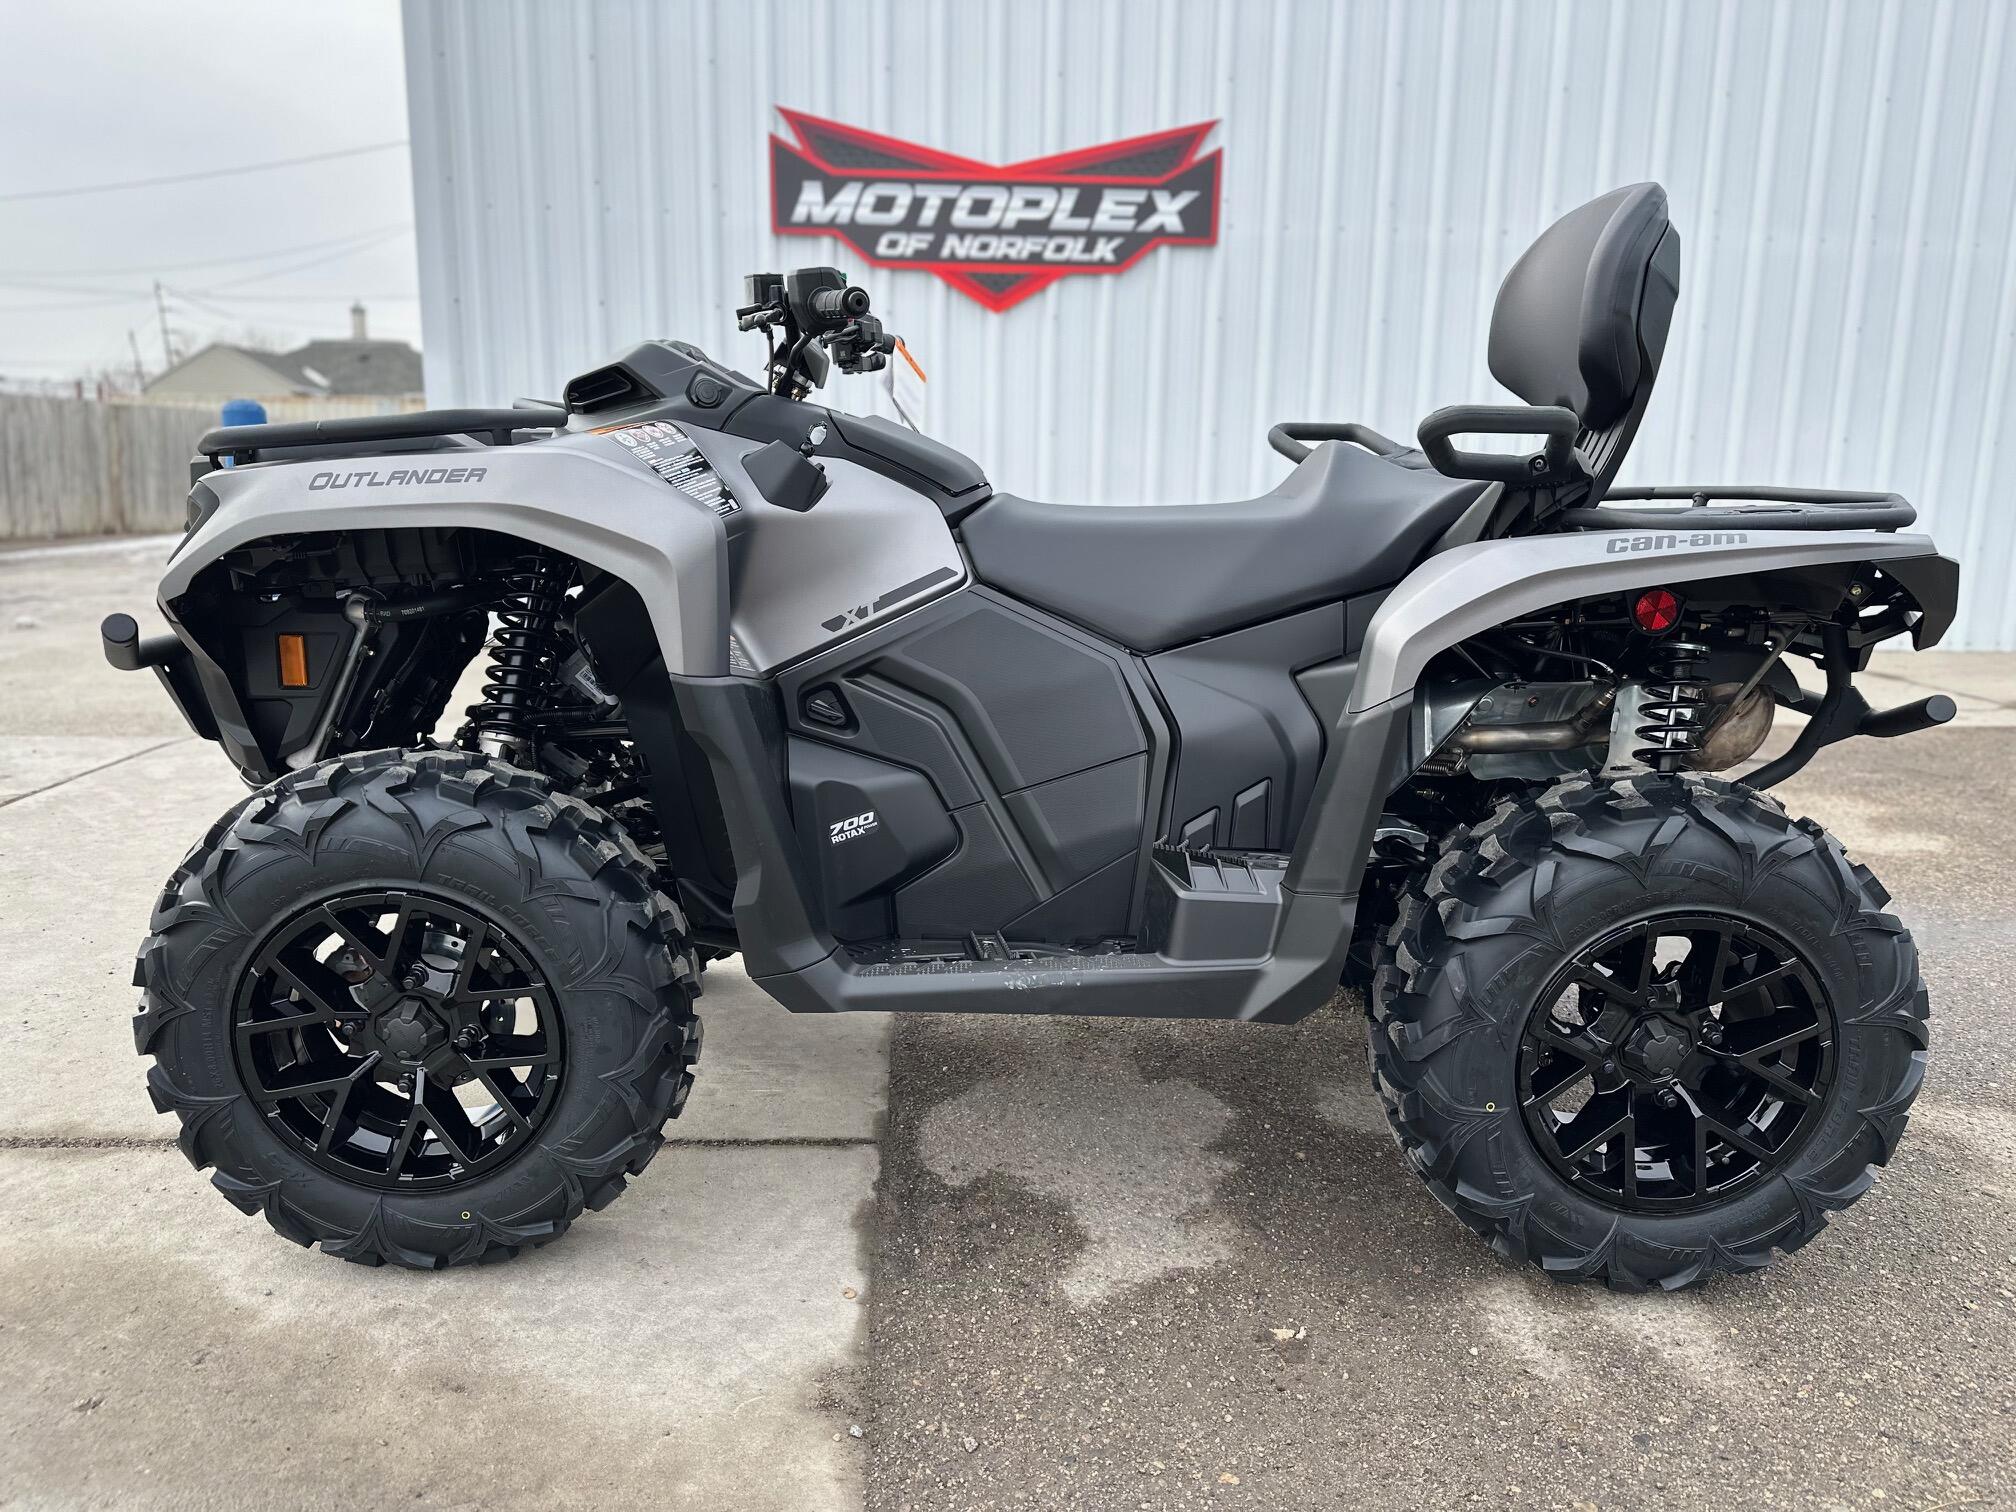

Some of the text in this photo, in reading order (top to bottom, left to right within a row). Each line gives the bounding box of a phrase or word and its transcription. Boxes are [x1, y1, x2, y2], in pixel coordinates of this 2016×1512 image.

[790, 181, 1200, 233] MOTOPLEX
[875, 232, 1122, 262] OF NORFOLK
[308, 467, 488, 491] OUTLANDER
[1606, 532, 1748, 554] can-am
[830, 811, 874, 836] 700
[831, 826, 865, 844] ROTAX
